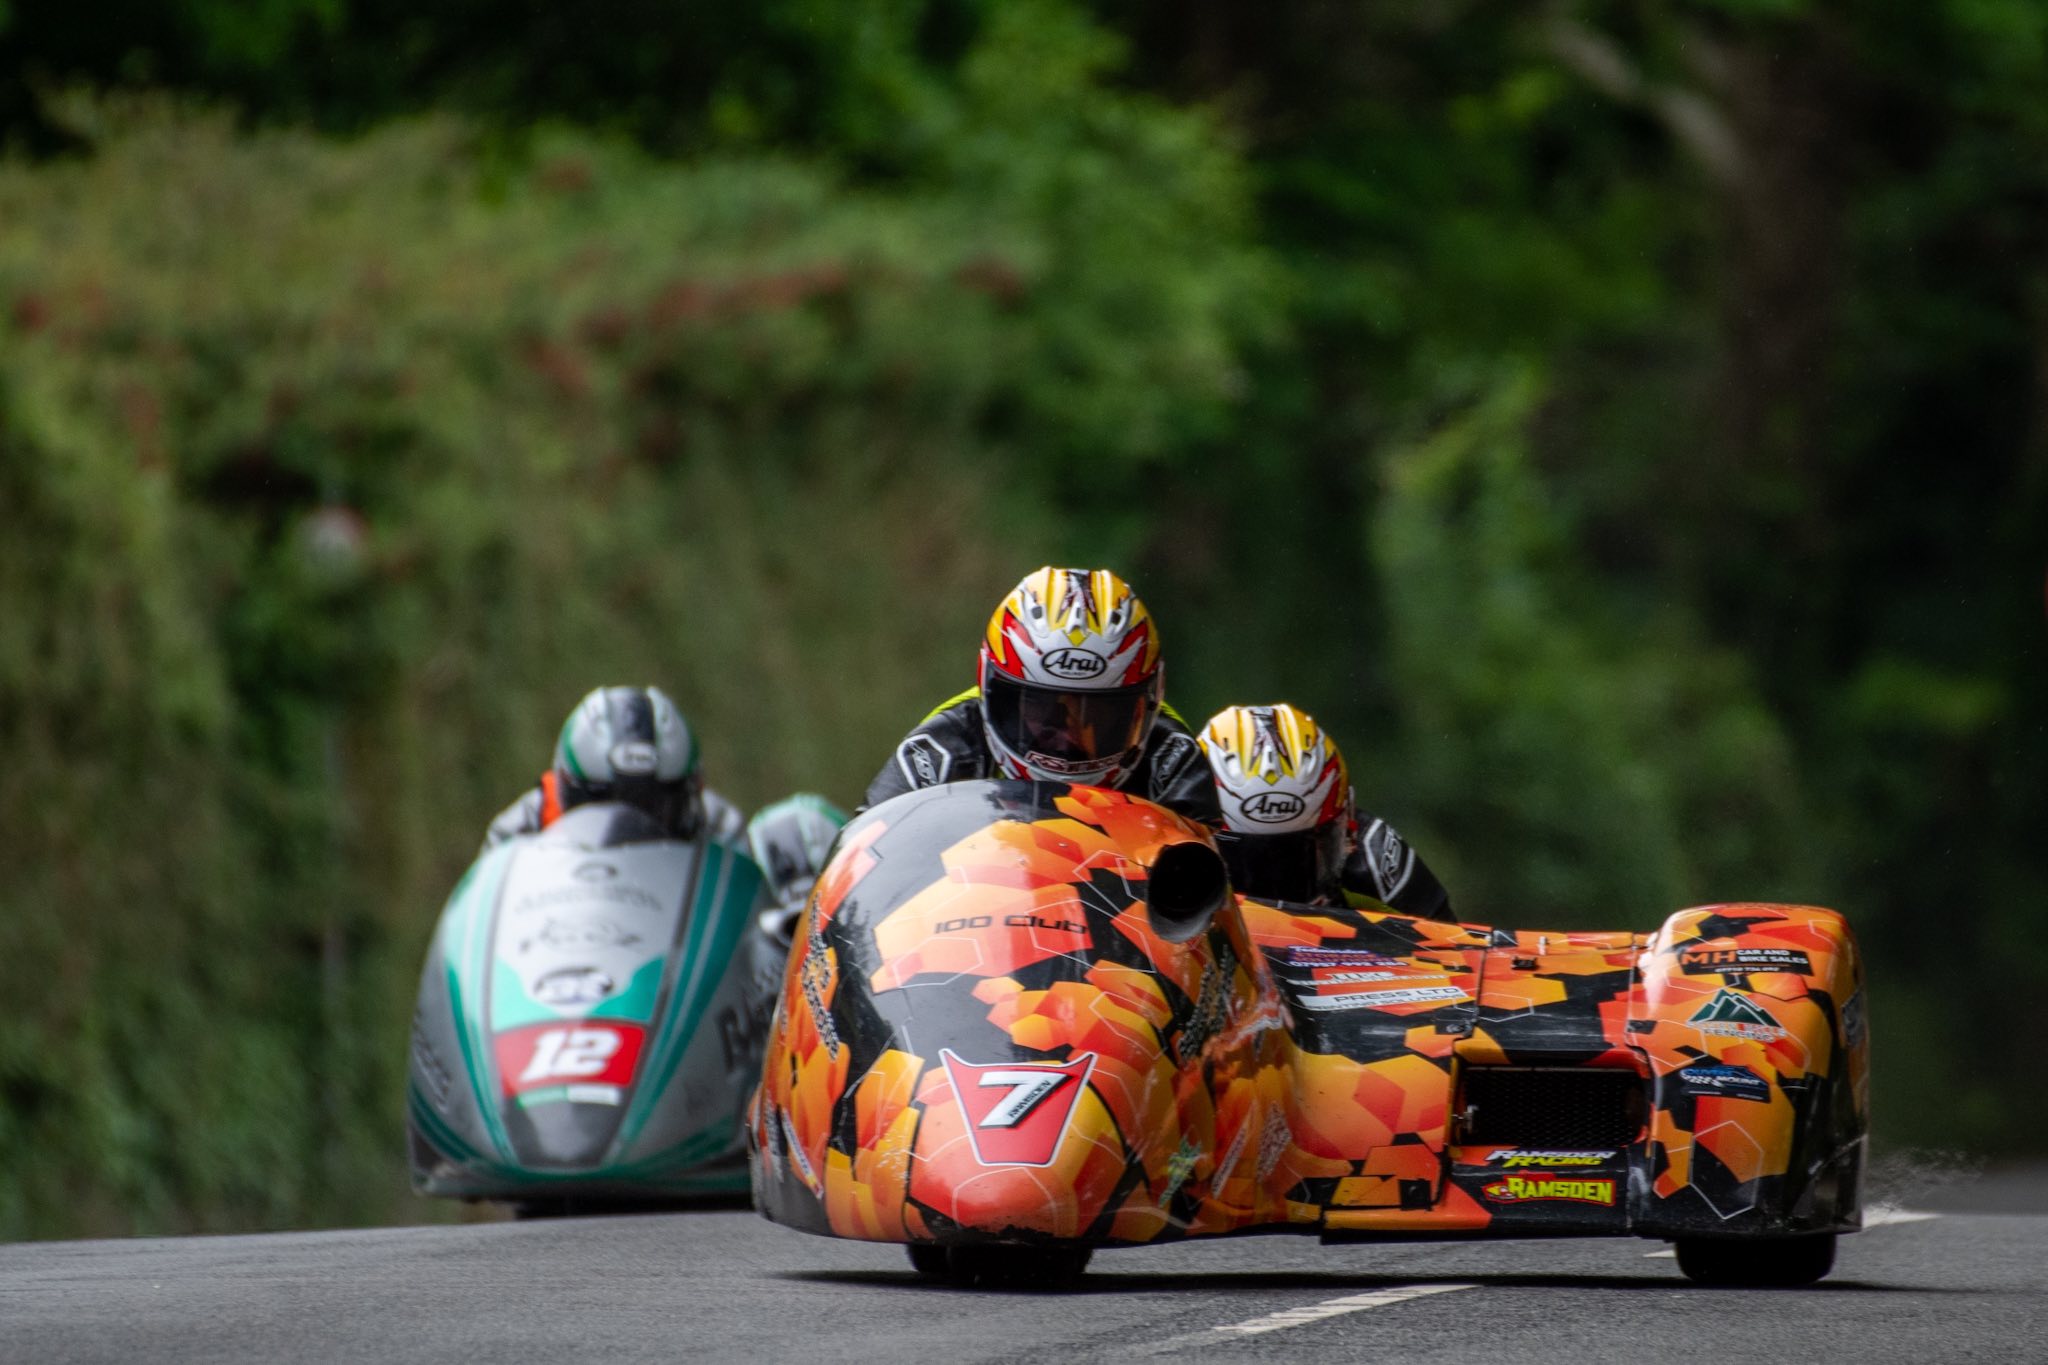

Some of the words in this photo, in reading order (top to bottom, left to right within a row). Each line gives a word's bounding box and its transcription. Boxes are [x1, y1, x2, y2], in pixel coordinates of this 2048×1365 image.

[1045, 650, 1099, 672] Arai
[1245, 796, 1299, 814] Arai
[934, 915, 993, 934] 100
[1004, 914, 1089, 935] Club
[1681, 951, 1737, 965] MH
[1769, 956, 1809, 964] SALES
[1334, 990, 1409, 1003] PRESS
[1416, 987, 1459, 998] LTD
[1704, 1029, 1775, 1042] FENCING
[518, 1028, 623, 1083] 12
[977, 1070, 1072, 1129] 7
[1008, 1080, 1052, 1119] RAMSDEN
[1485, 1150, 1617, 1160] RAMSDEN
[1502, 1156, 1604, 1168] RACING
[1506, 1177, 1613, 1204] RAMSDEN
